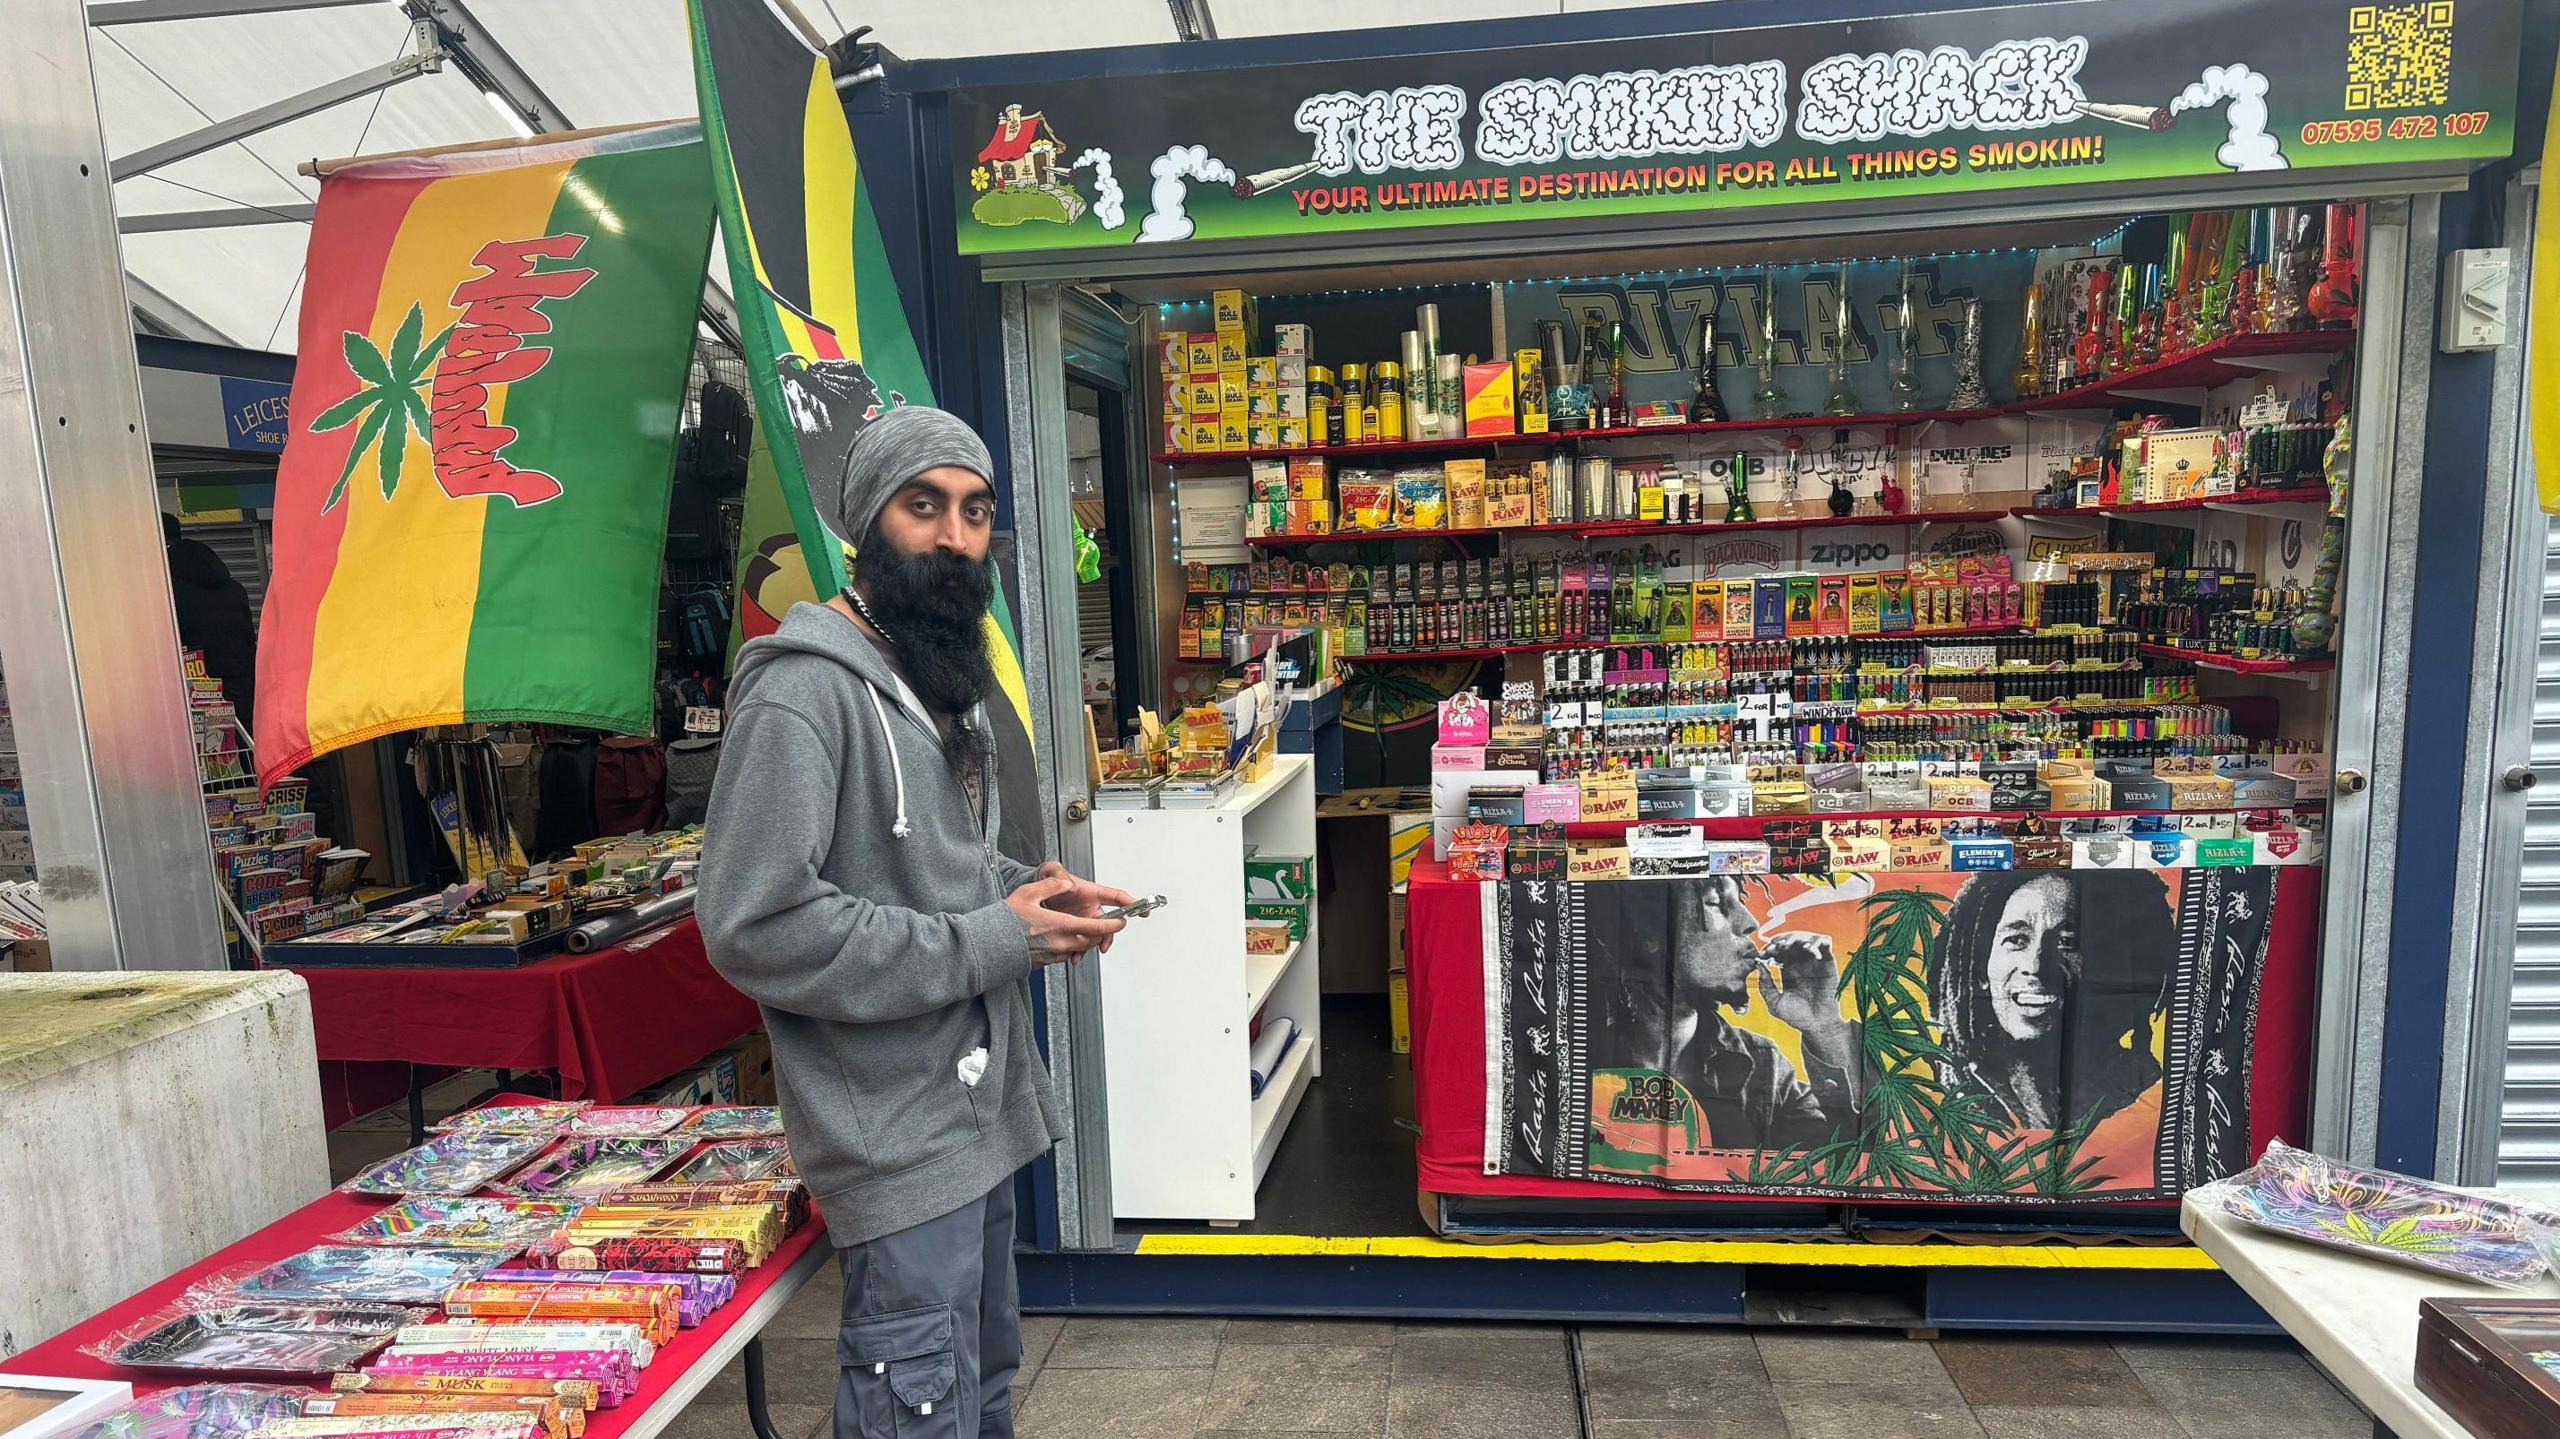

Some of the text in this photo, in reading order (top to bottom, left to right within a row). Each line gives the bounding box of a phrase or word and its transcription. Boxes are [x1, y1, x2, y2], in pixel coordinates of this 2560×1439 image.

[1294, 35, 2089, 176] THE SMOKIN SHACK
[2301, 112, 2490, 146] 07595 472 107
[1292, 135, 2105, 217] YOUR ULTIMATE DESTINATION FOR ALL THINGS SMOKIN!
[255, 430, 280, 444] SHOE
[1450, 483, 1480, 499] RAW
[1492, 506, 1524, 520] RAW
[1704, 540, 1781, 579] BACKWOODS
[1740, 696, 1752, 710] 2
[1552, 704, 1563, 720] 2
[1803, 706, 1855, 718] WINDPROOF
[1185, 713, 1221, 727] RAW
[1178, 759, 1210, 770] RAW
[2162, 759, 2174, 771] 2
[2218, 756, 2230, 769] 2
[1751, 767, 1763, 781] 2
[1821, 767, 1838, 779] OCB
[1868, 764, 1878, 776] 2
[1927, 763, 1939, 777] 2
[1988, 773, 2027, 785] OCB
[268, 787, 306, 805] CRISS
[1818, 799, 1844, 807] OCB
[1949, 797, 1973, 805] OCB
[2125, 793, 2158, 801] RIZLA+
[2184, 793, 2224, 801] RIZLA+
[1593, 799, 1627, 813] RAW
[2127, 817, 2138, 831] 2
[2184, 816, 2194, 828] 2
[2241, 812, 2252, 825] 2
[1830, 824, 1839, 836] 2
[1950, 821, 1960, 833] 2
[2066, 821, 2077, 833] 2
[1782, 851, 1820, 865] RAW
[1844, 852, 1879, 865] RAW
[1905, 851, 1942, 865] RAW
[1959, 850, 2006, 858] ELEMENTS
[2205, 847, 2246, 857] RIZLA+
[234, 853, 269, 869] Puzzles
[1523, 858, 1557, 873] RAW
[1581, 857, 1619, 871] RAW
[246, 873, 287, 893] CODE
[247, 889, 282, 905] BREAKS
[305, 909, 333, 925] Sudoku
[1259, 906, 1298, 916] ZIG-ZAG
[1522, 917, 1547, 1015] Rasta
[2215, 935, 2245, 1034] Rasta
[1628, 1077, 1677, 1099] BOB
[1521, 1069, 1548, 1165] Rasta
[1613, 1097, 1690, 1123] MARLEY
[463, 1354, 535, 1364] YLANG YLANG
[445, 1367, 518, 1377] YLANG YLANG
[436, 1378, 486, 1390] MUSK
